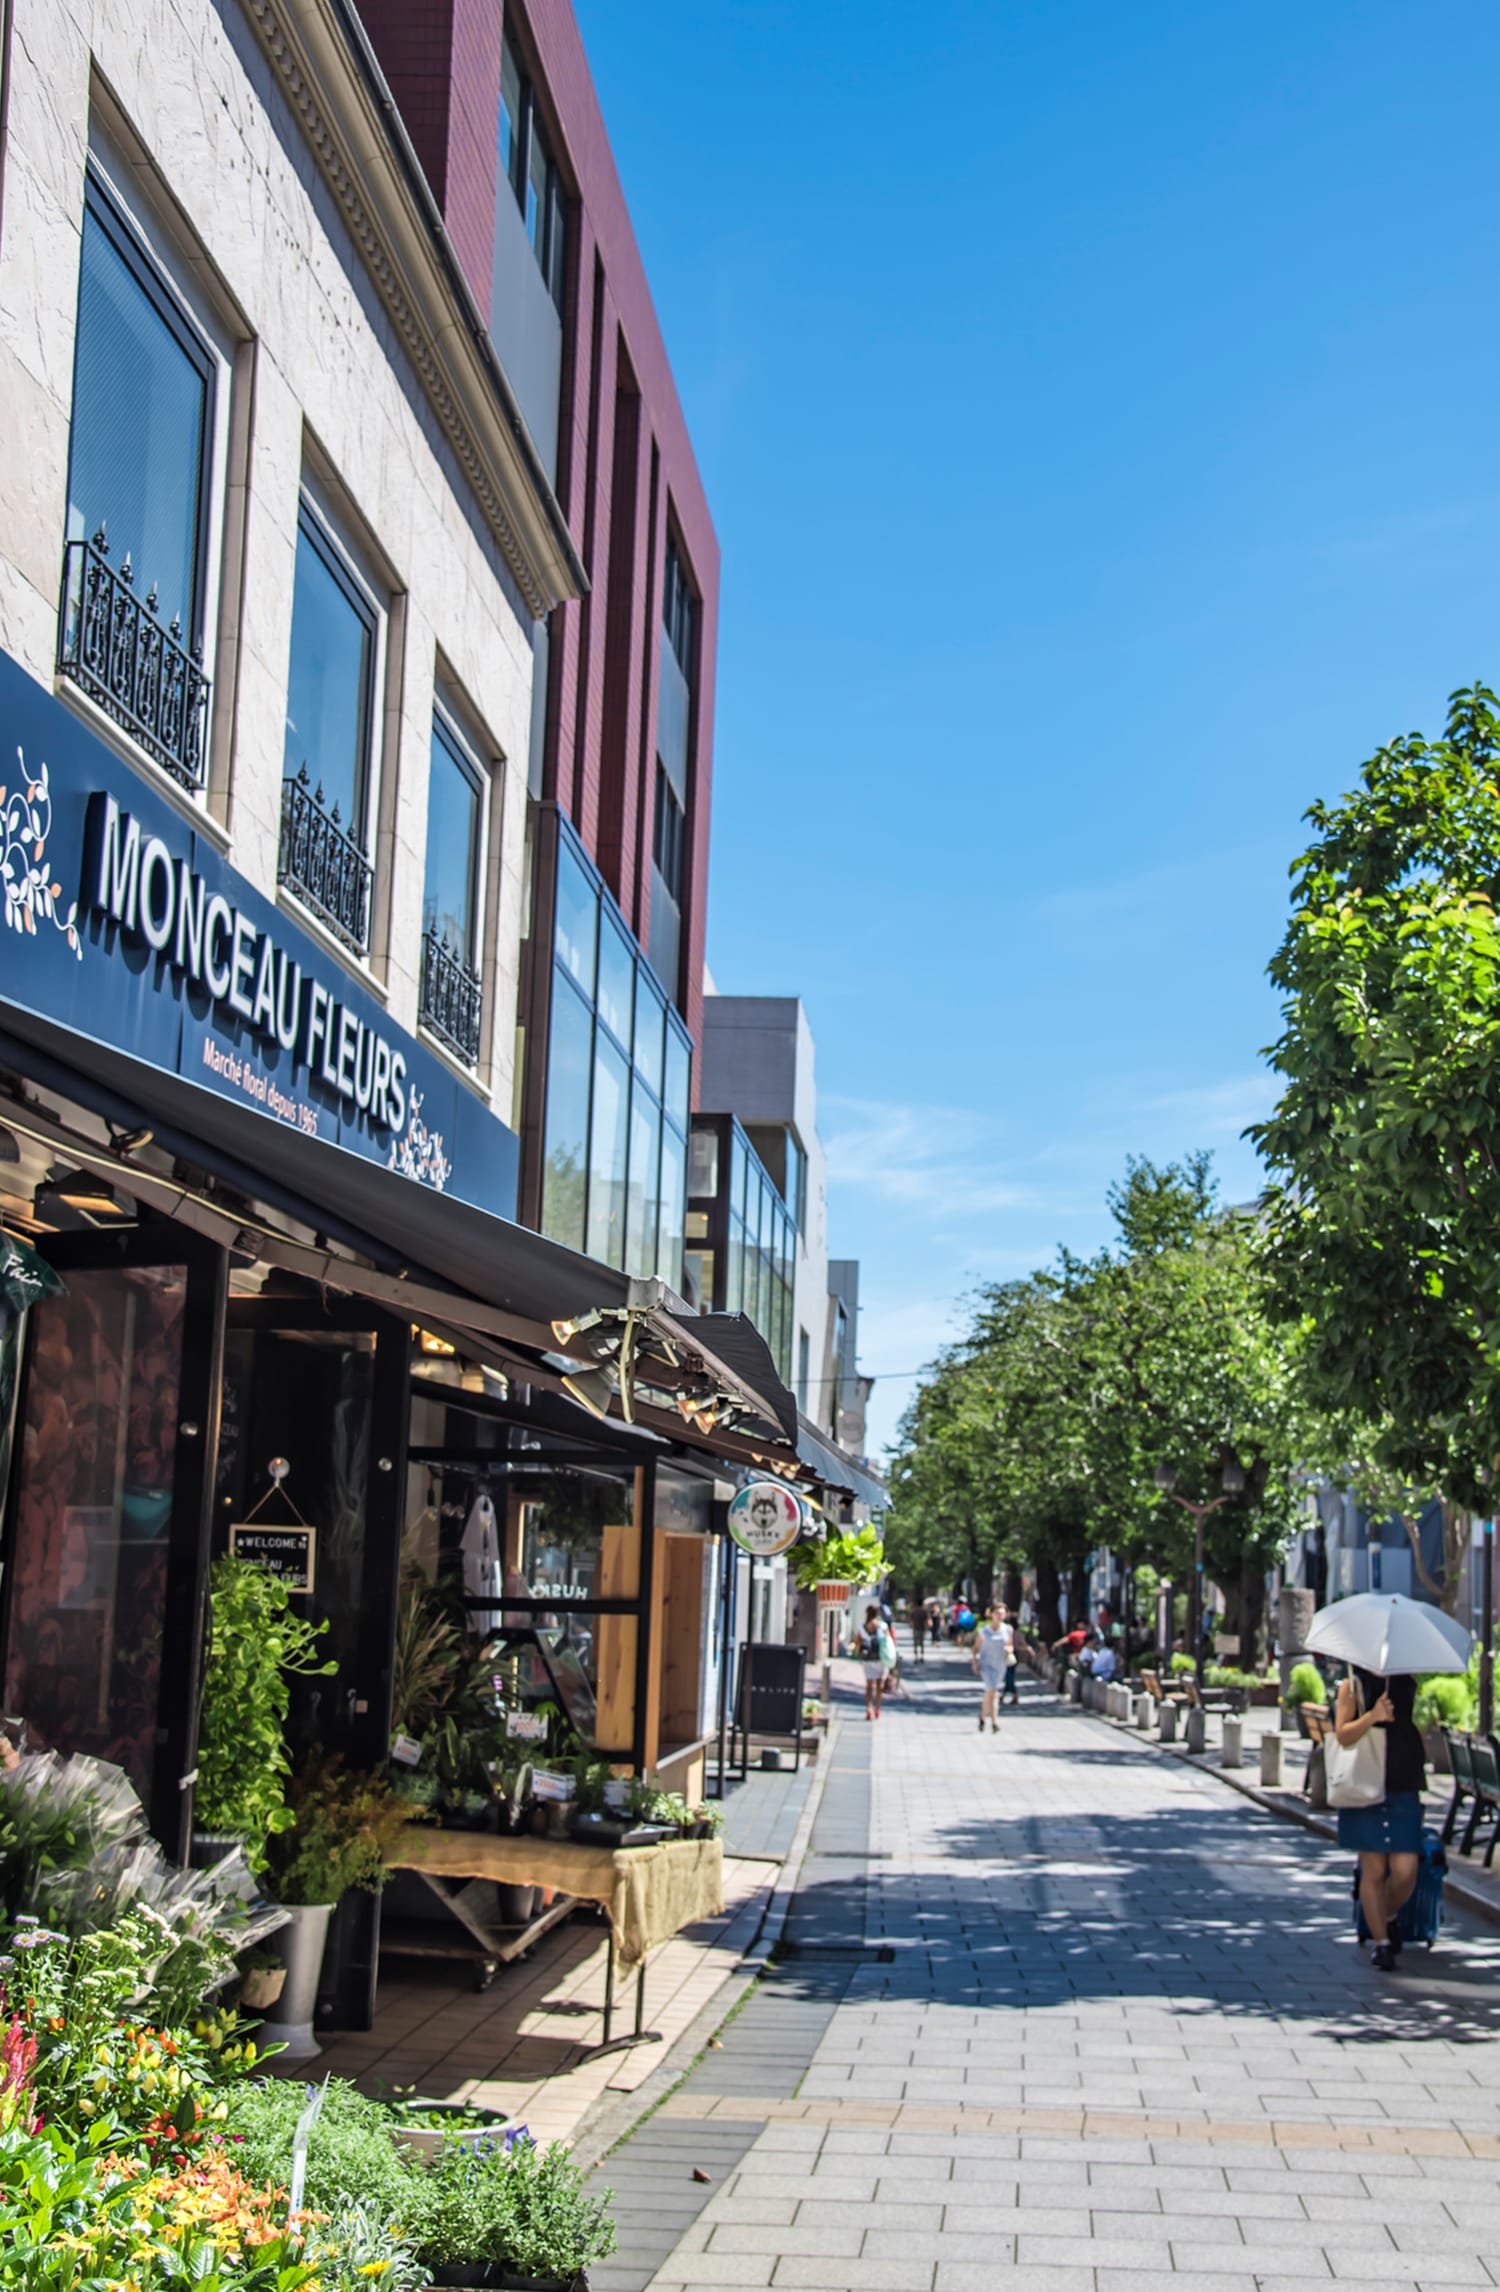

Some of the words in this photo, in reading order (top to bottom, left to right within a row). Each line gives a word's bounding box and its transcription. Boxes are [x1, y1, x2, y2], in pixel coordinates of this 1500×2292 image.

[96, 793, 301, 1050] MONCEAU
[306, 980, 407, 1133] FLEURS
[203, 1036, 242, 1086] Marché
[242, 1062, 268, 1102] floral
[267, 1081, 297, 1123] depuis
[298, 1103, 319, 1136] 1965
[245, 1536, 297, 1549] WELCOME
